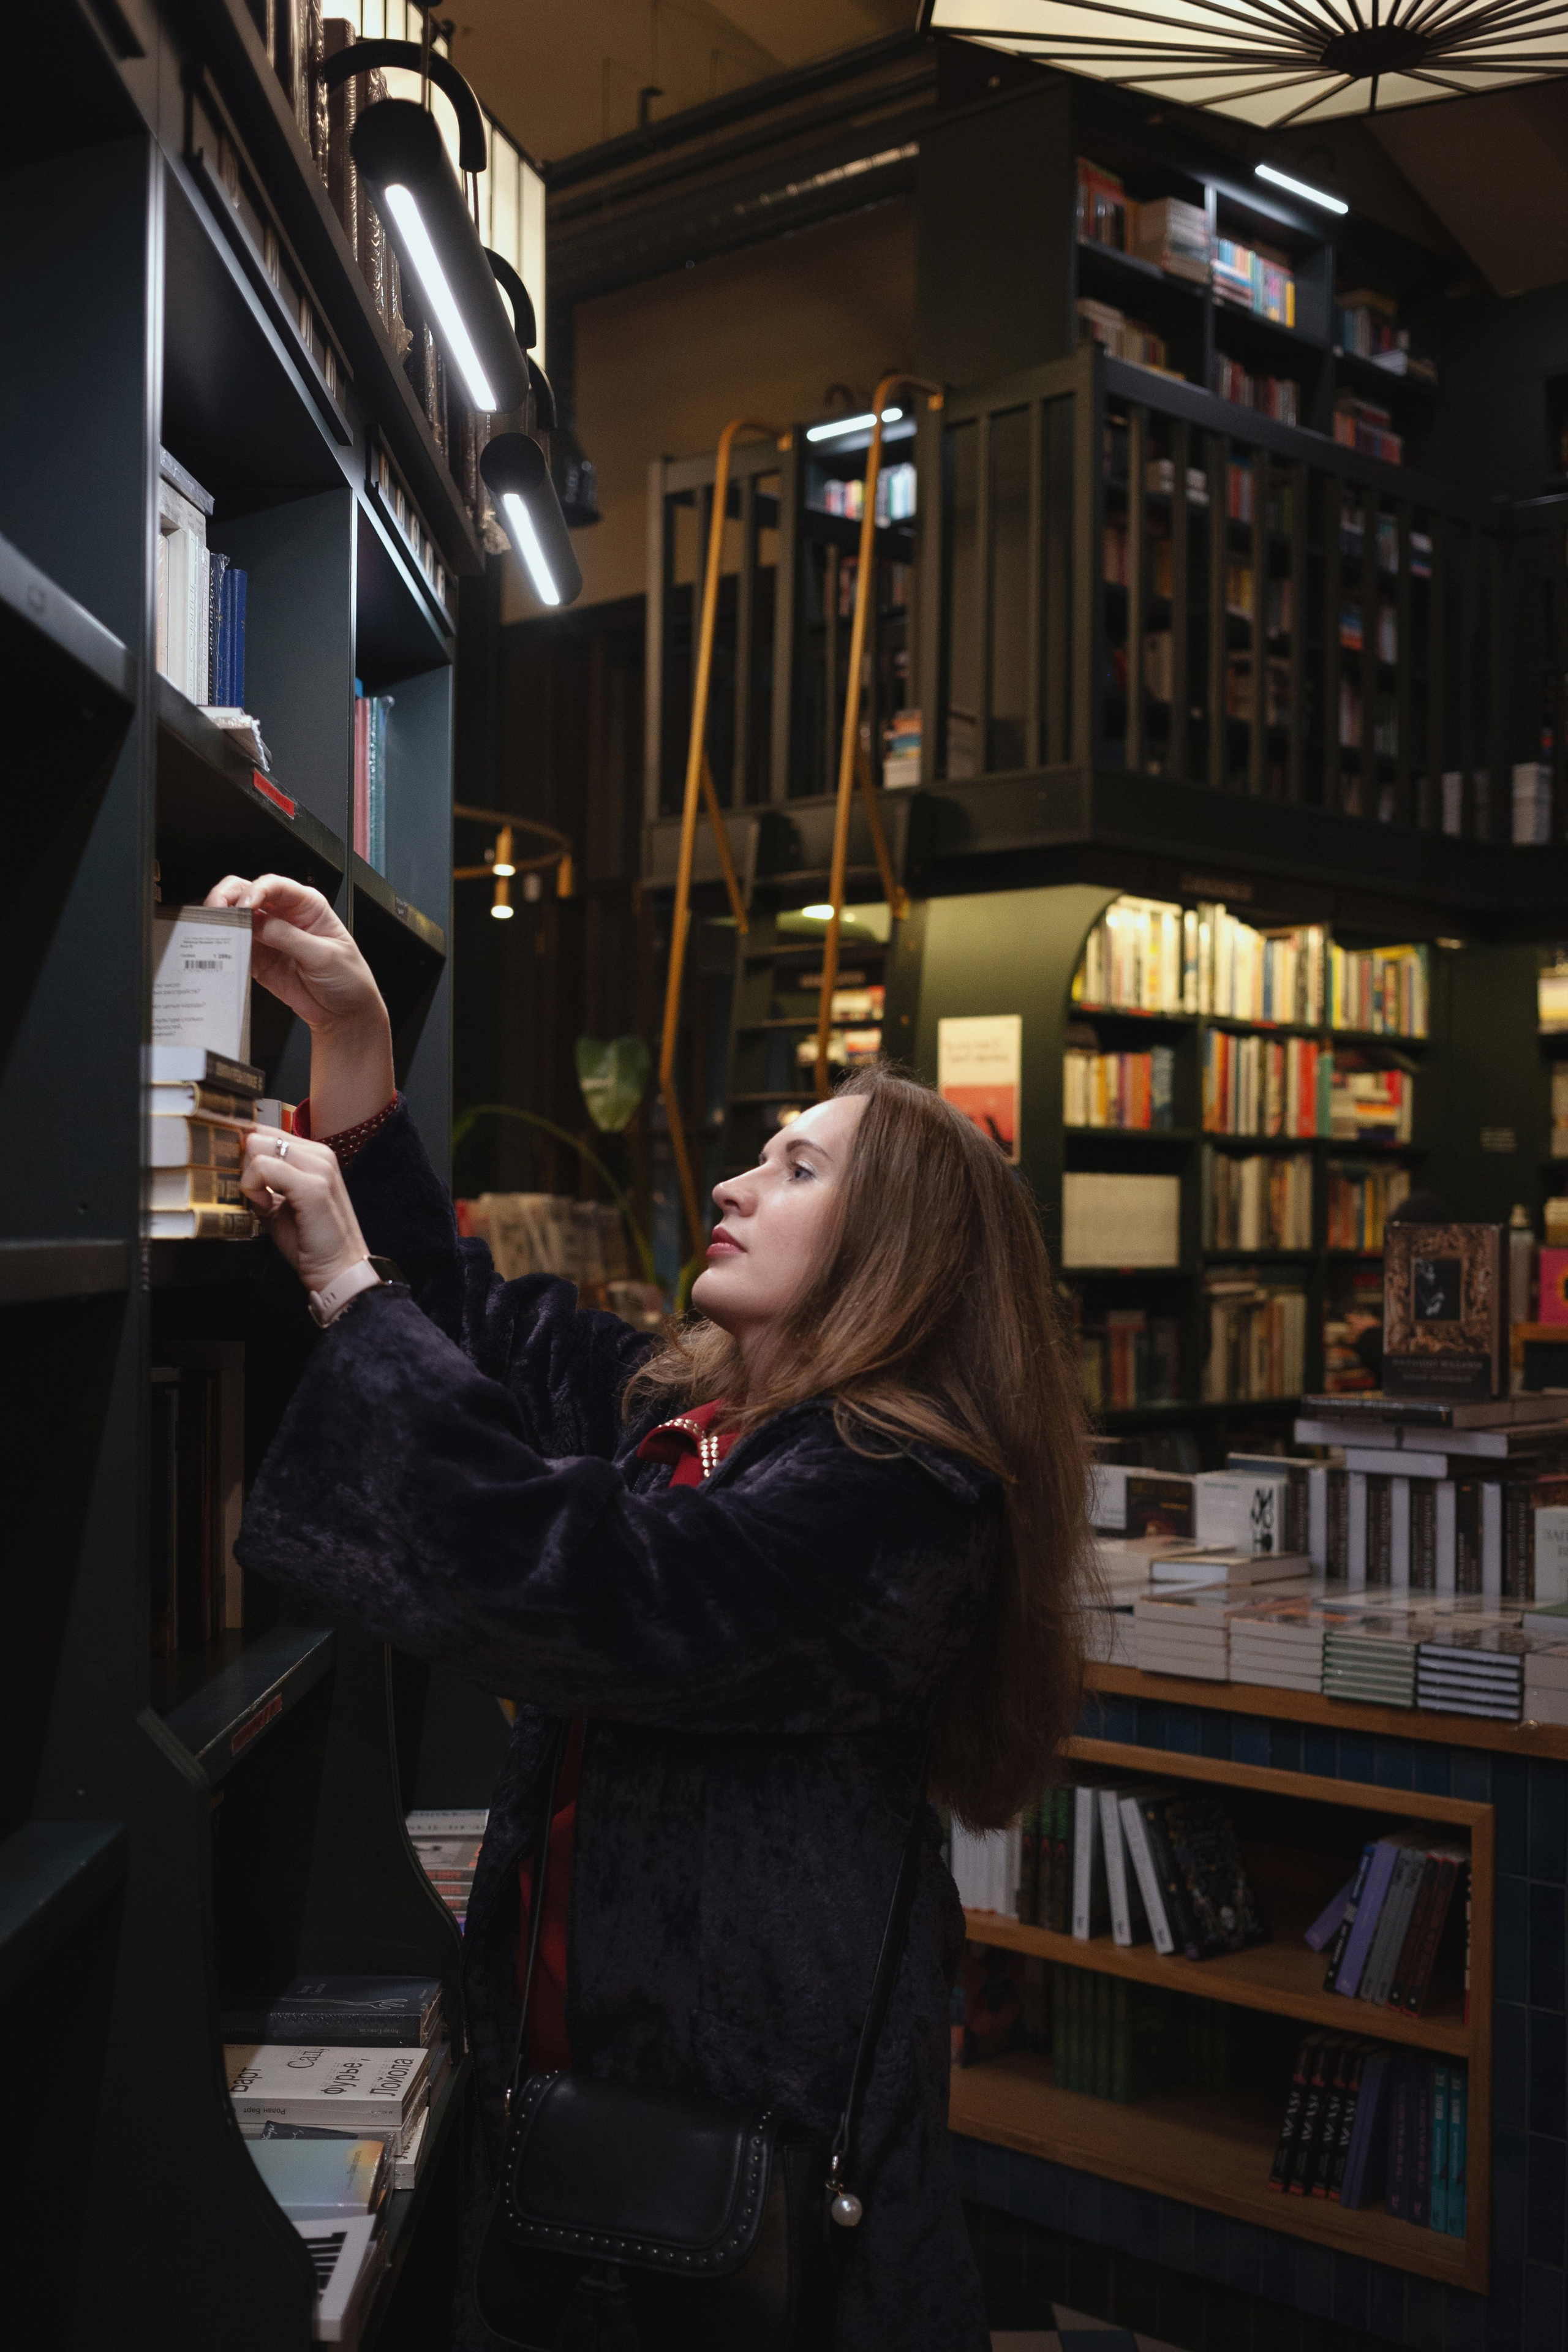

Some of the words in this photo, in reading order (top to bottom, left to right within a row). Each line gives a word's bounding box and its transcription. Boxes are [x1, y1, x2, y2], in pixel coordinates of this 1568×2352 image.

[287, 2048, 330, 2068] Сад,
[230, 2067, 262, 2093] Барт
[369, 2058, 414, 2097] Лойола
